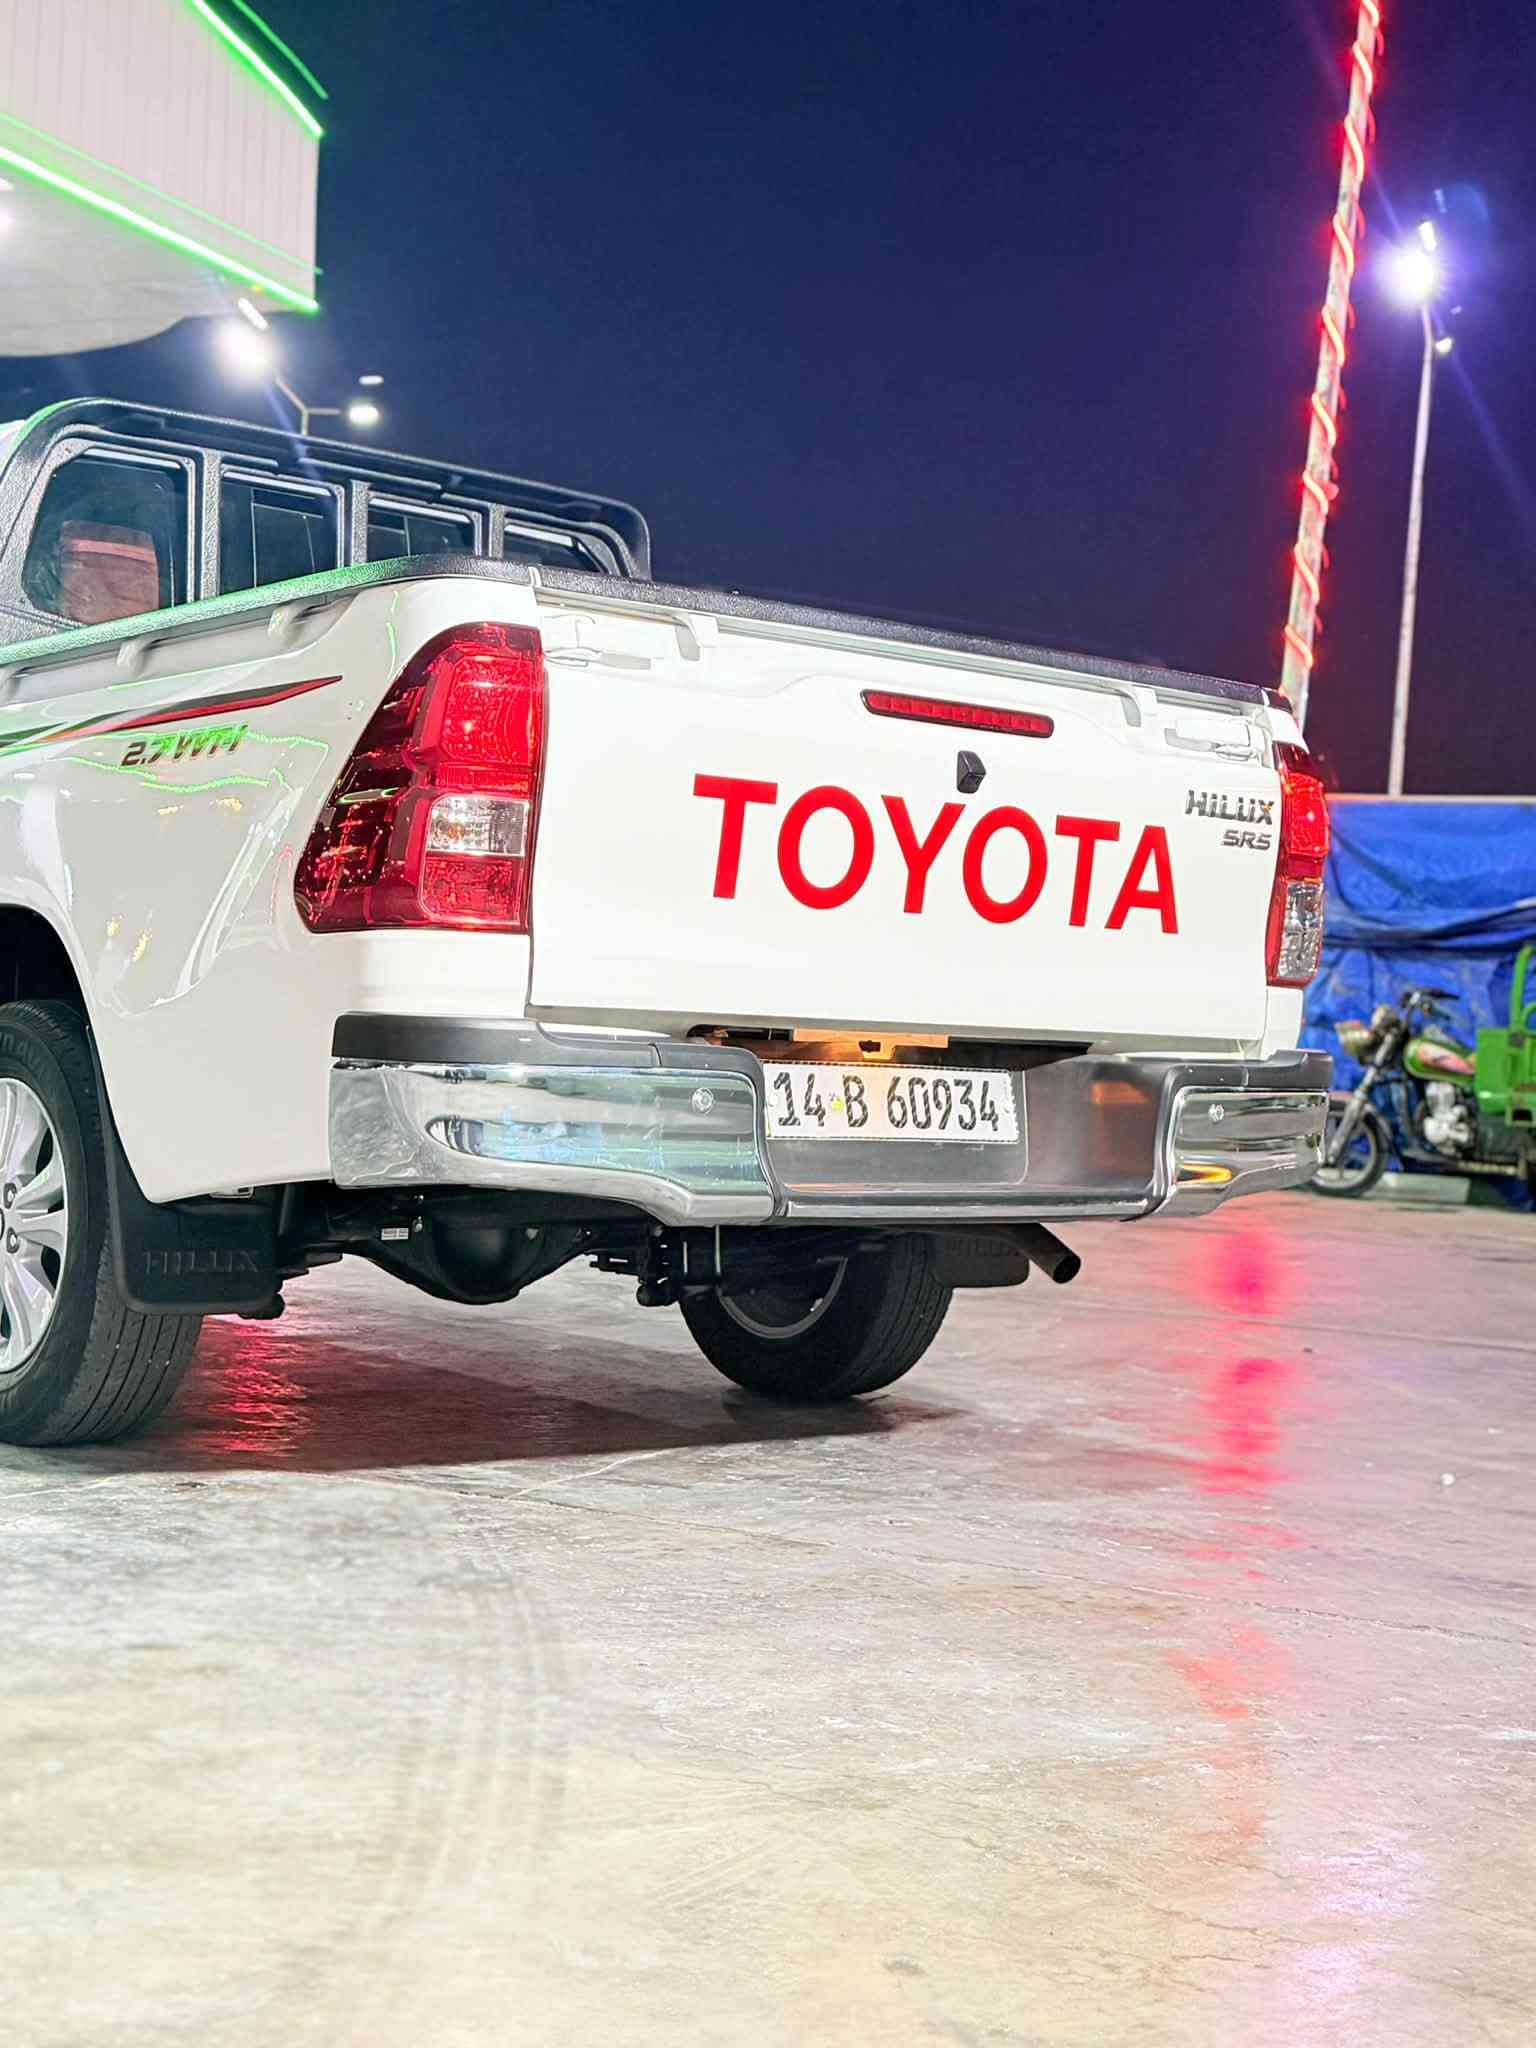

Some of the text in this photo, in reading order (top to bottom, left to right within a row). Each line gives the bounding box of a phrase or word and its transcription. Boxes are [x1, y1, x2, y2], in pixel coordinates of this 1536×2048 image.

[1185, 789, 1274, 825] HILUX
[693, 773, 1179, 934] TOYOTA
[774, 1071, 999, 1131] 14 B 60934
